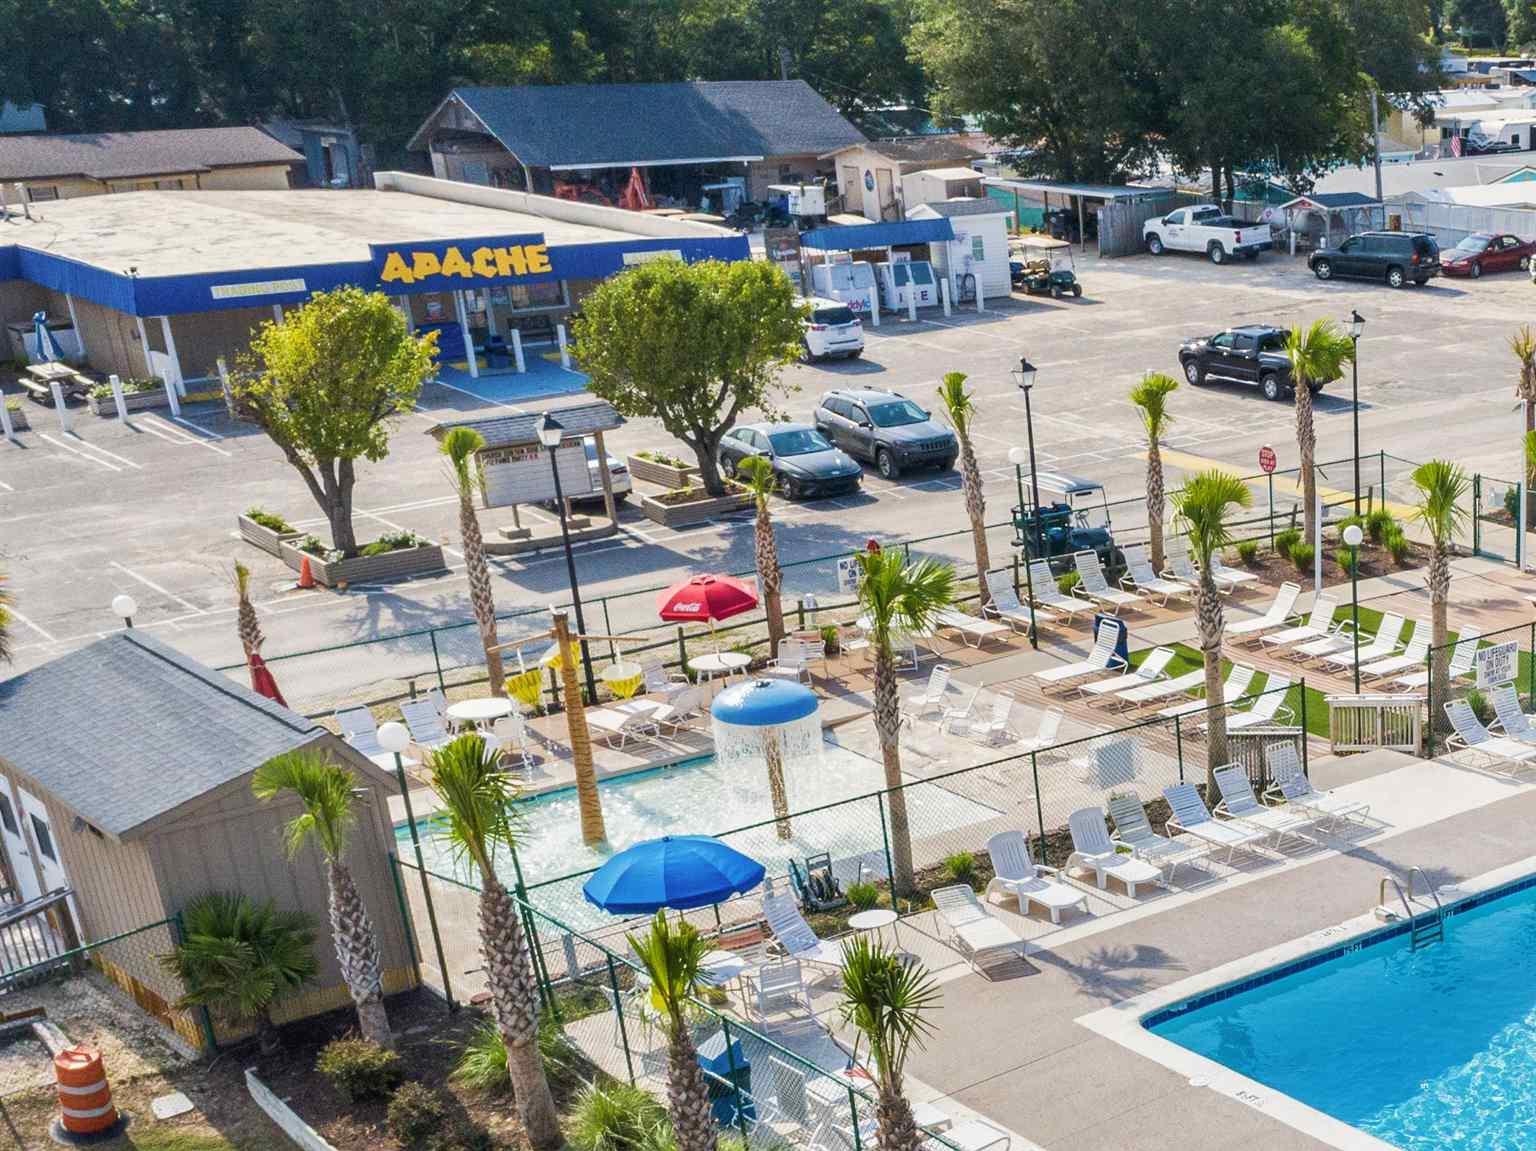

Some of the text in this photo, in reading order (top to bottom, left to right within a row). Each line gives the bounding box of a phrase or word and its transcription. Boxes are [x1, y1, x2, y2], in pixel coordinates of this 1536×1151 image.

[381, 245, 552, 284] APACHE
[1478, 642, 1518, 662] NO LIFEGUARD
[1486, 653, 1509, 670] ON DUTY
